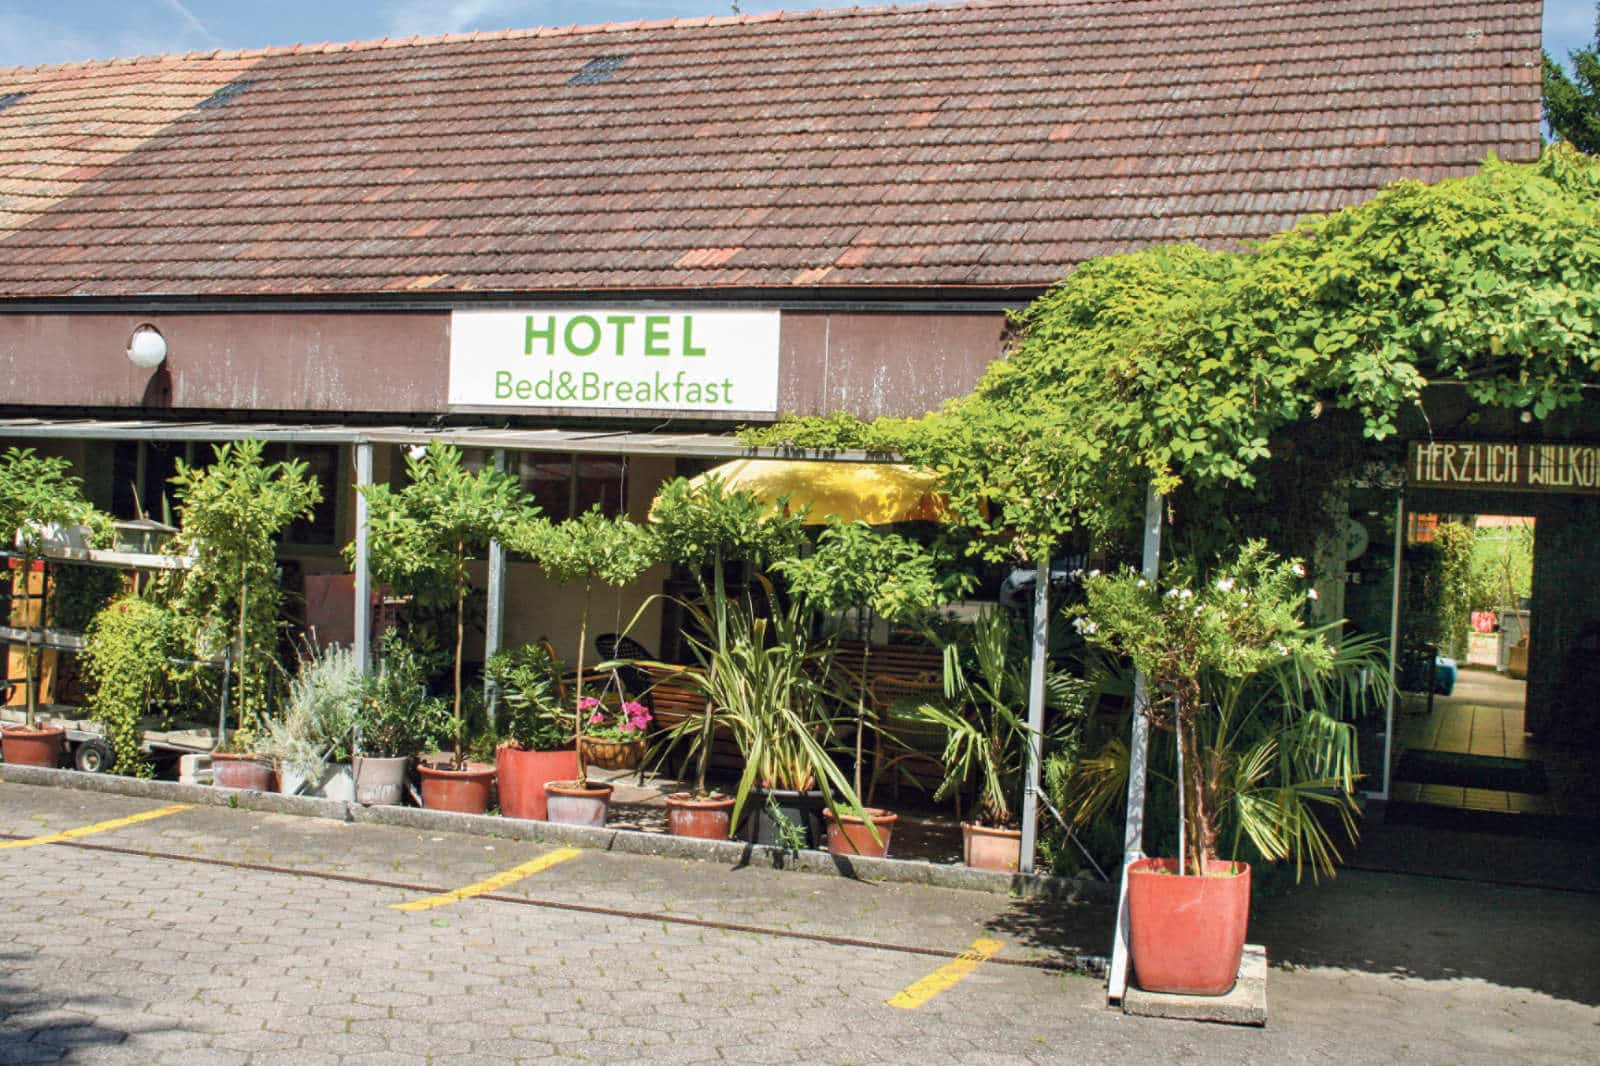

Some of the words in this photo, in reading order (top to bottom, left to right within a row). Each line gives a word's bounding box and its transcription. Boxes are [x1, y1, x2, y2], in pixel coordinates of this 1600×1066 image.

[524, 315, 706, 357] HOTEL
[495, 369, 734, 404] Bed&Breakfast
[1416, 444, 1518, 483] HERZLICH
